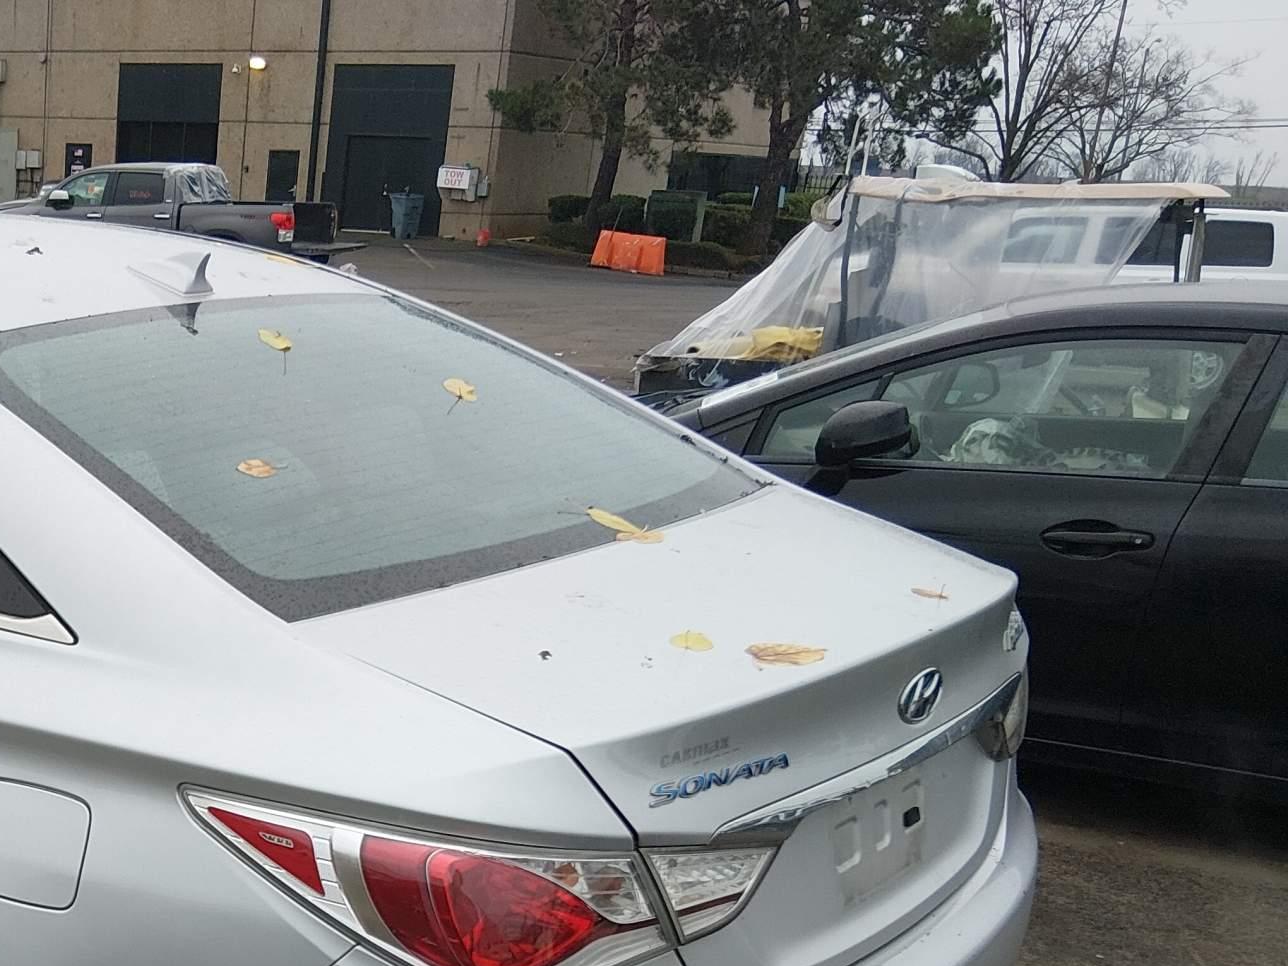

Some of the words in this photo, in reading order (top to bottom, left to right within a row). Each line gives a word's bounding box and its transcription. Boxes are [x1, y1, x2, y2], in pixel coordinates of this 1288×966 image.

[444, 170, 464, 178] TOW
[443, 178, 462, 186] OUT
[648, 752, 791, 808] SONATA
